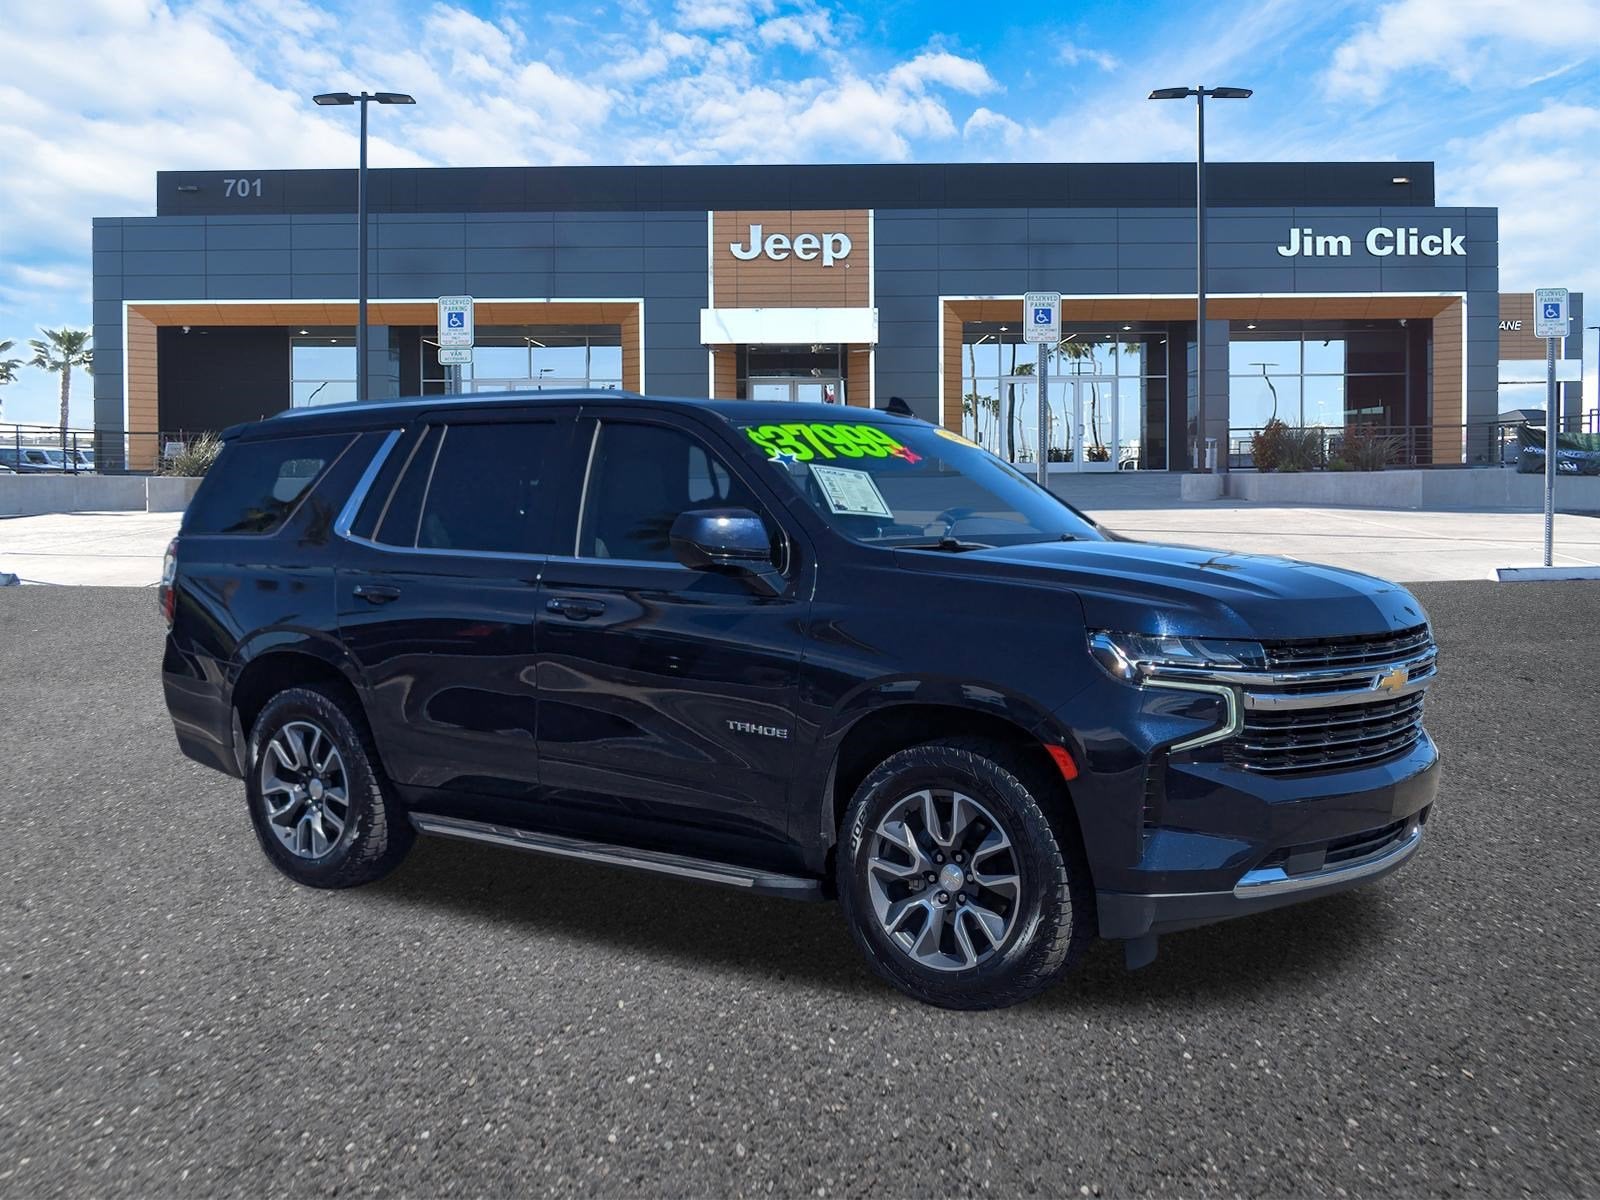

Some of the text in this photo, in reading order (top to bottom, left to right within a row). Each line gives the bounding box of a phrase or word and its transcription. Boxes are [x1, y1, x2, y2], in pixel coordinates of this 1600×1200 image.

[223, 178, 262, 197] 701
[730, 224, 852, 267] Jeep
[1277, 227, 1467, 257] Jim Click
[1498, 320, 1522, 331] ANE
[746, 423, 904, 461] $37999
[725, 719, 788, 739] TAHOE
